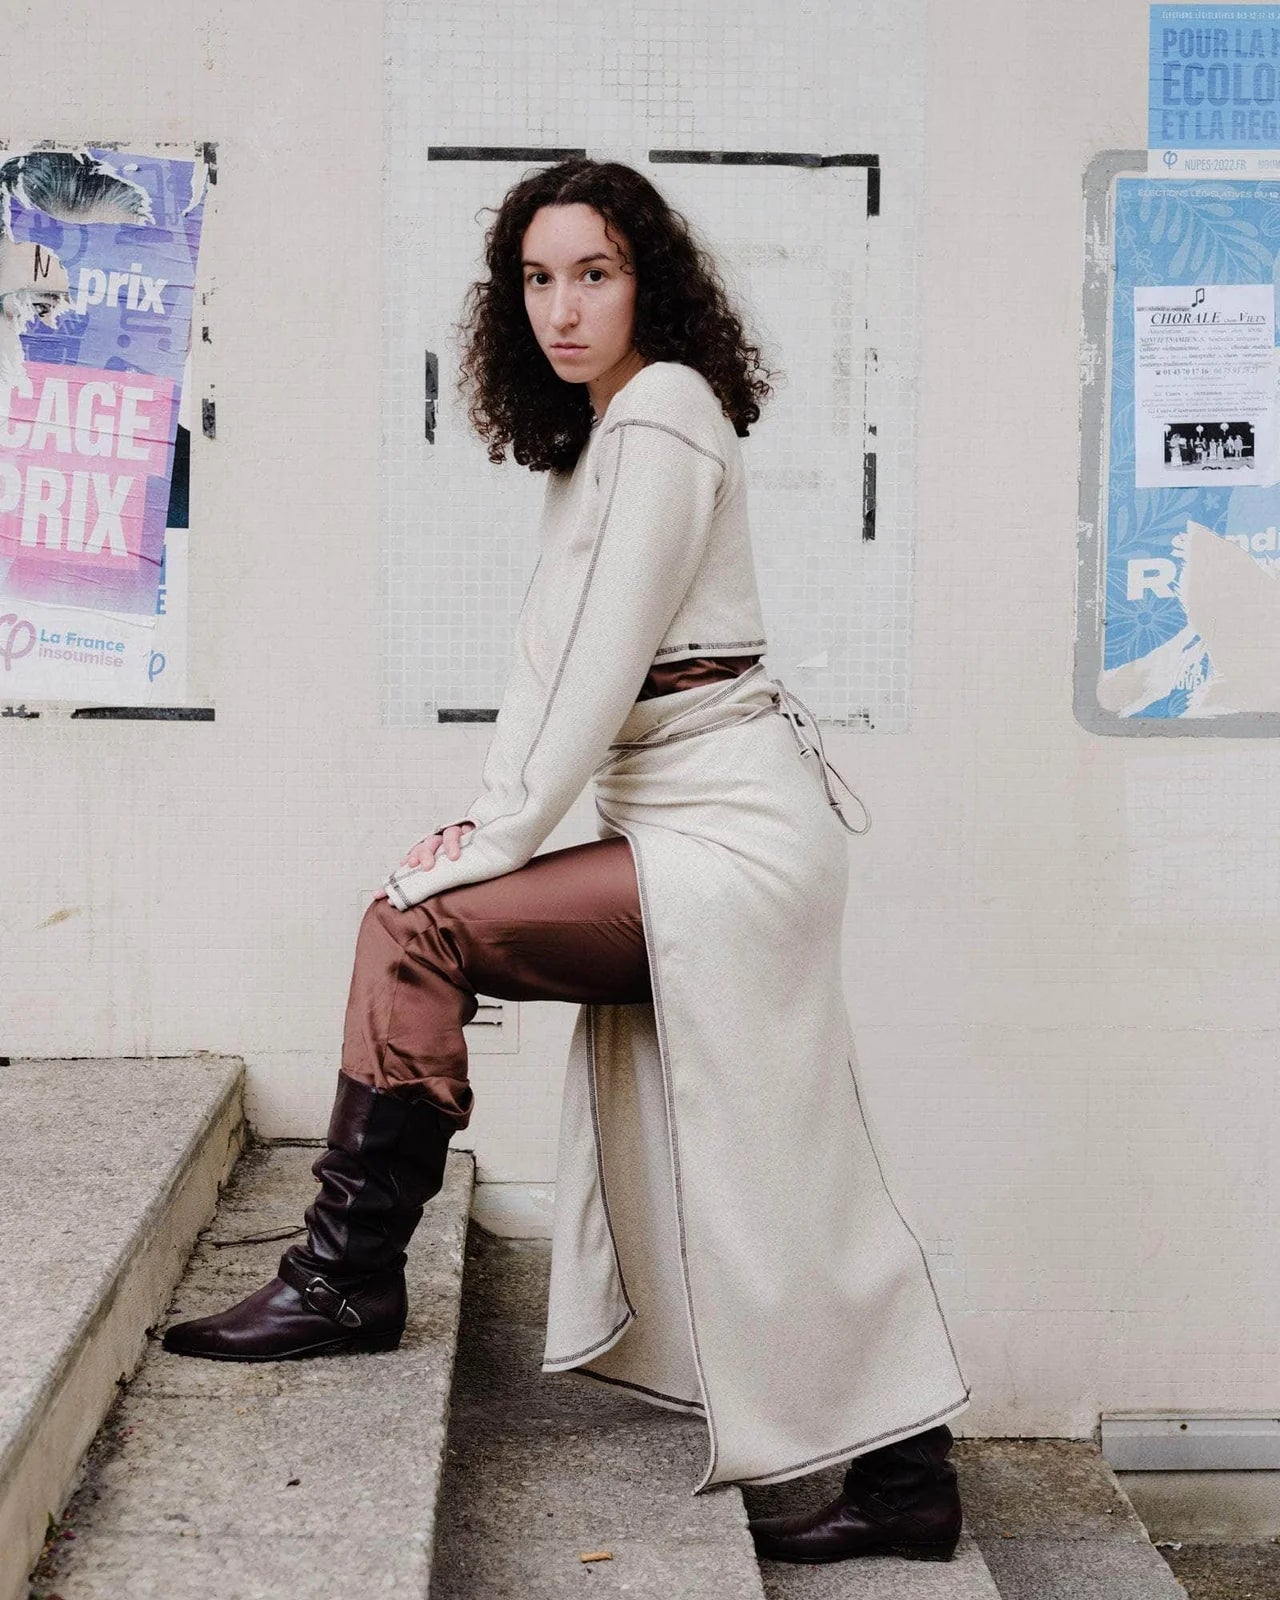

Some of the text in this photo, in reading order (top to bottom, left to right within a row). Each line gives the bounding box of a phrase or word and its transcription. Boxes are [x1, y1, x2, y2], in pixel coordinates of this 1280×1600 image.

[1163, 27, 1228, 58] POUR
[1235, 28, 1264, 58] LA
[1162, 61, 1280, 106] ECOLO
[1162, 110, 1188, 140] ET
[1195, 110, 1224, 140] LA
[75, 262, 169, 315] prix
[1151, 311, 1222, 325] CHORALE
[0, 378, 153, 460] CAGE
[38, 643, 124, 668] insoumise
[40, 628, 125, 653] La France
